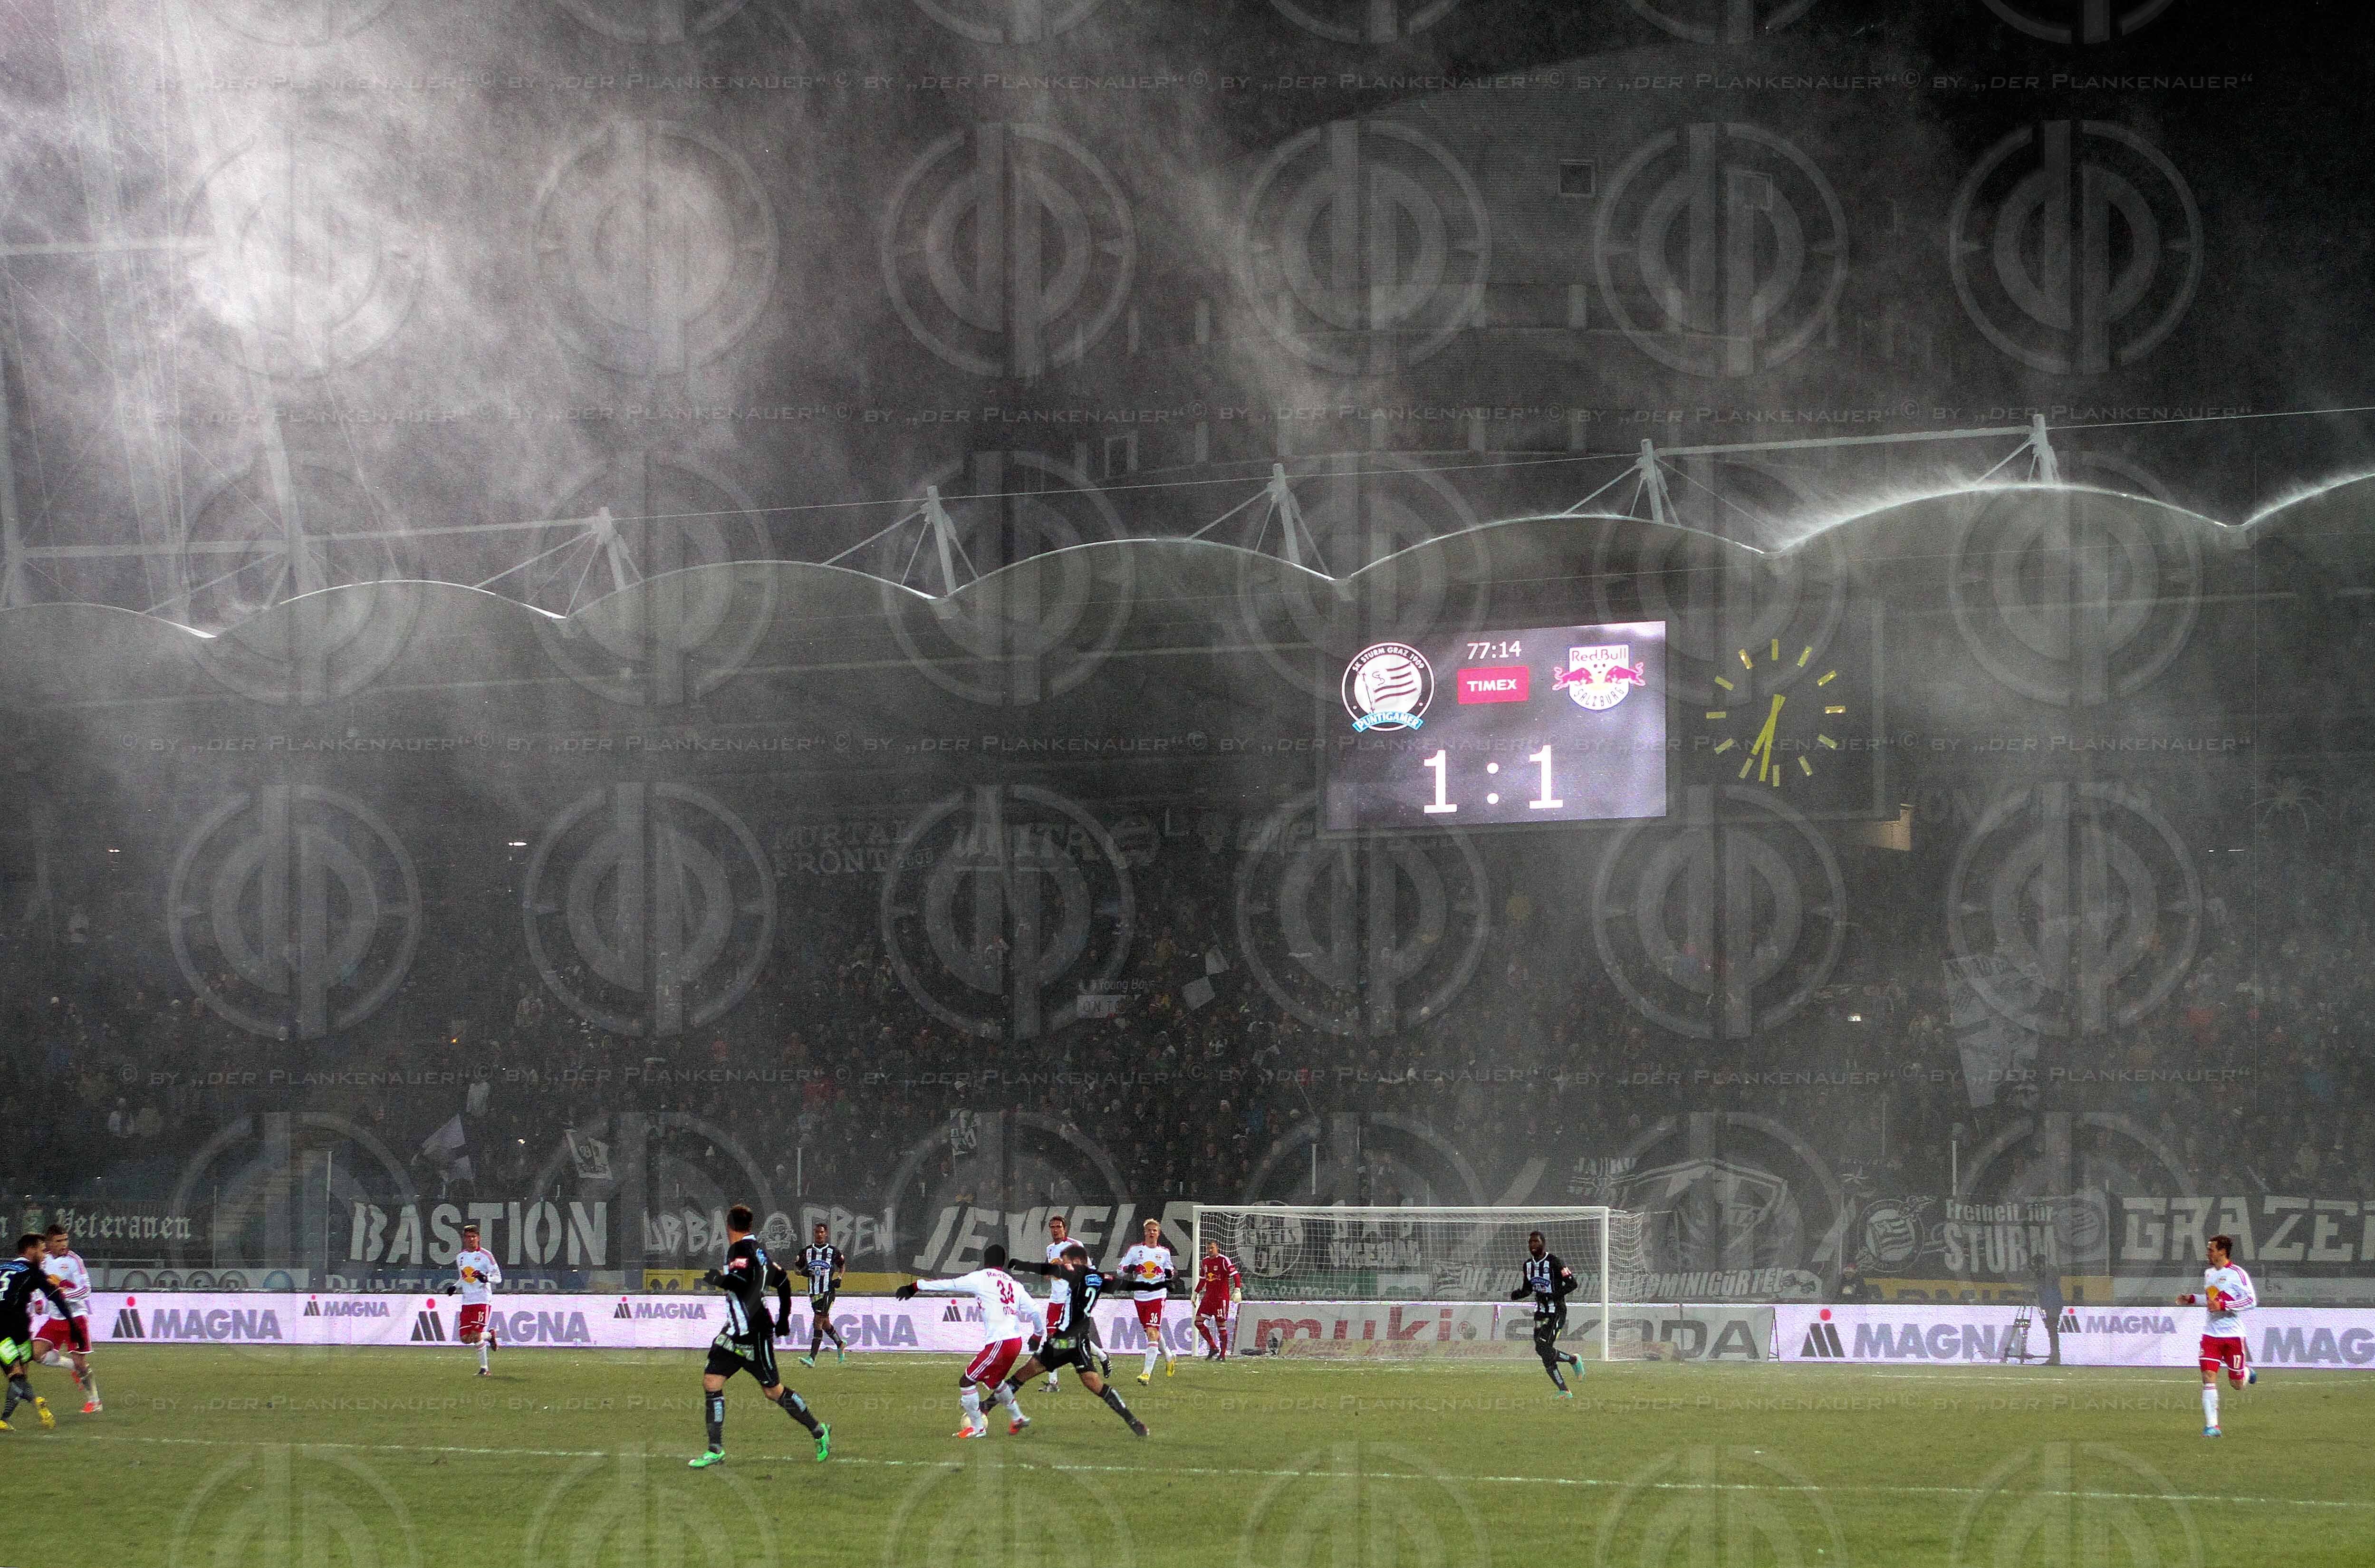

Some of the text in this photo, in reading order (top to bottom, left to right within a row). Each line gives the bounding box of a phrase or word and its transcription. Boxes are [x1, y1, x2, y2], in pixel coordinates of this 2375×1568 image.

[1352, 646, 1425, 672] SK STURM GRAZ 1909
[1468, 641, 1521, 660] 77:14
[1466, 678, 1517, 693] TIMEX
[1573, 686, 1625, 707] SALZBURG
[1356, 712, 1421, 731] PUNTIGAMER
[1423, 749, 1458, 814] 1
[1529, 744, 1564, 809] 1
[56, 1208, 191, 1240] Veteranen
[350, 1201, 607, 1266] BASTION
[643, 1207, 728, 1258] URBA
[912, 1201, 1202, 1276] JEWELS
[1943, 1222, 2060, 1273] STURM
[997, 1279, 1015, 1304] 34
[324, 1300, 390, 1317] MAGNA
[635, 1303, 707, 1320] MAGNA
[1150, 1312, 1158, 1323] 36
[152, 1308, 282, 1339] MAGNA
[452, 1311, 591, 1342] AGNA
[1254, 1306, 1453, 1348] muki
[2086, 1315, 2176, 1334] MAGNA
[1853, 1323, 2026, 1359] MAGNA
[2233, 1354, 2241, 1369] 17
